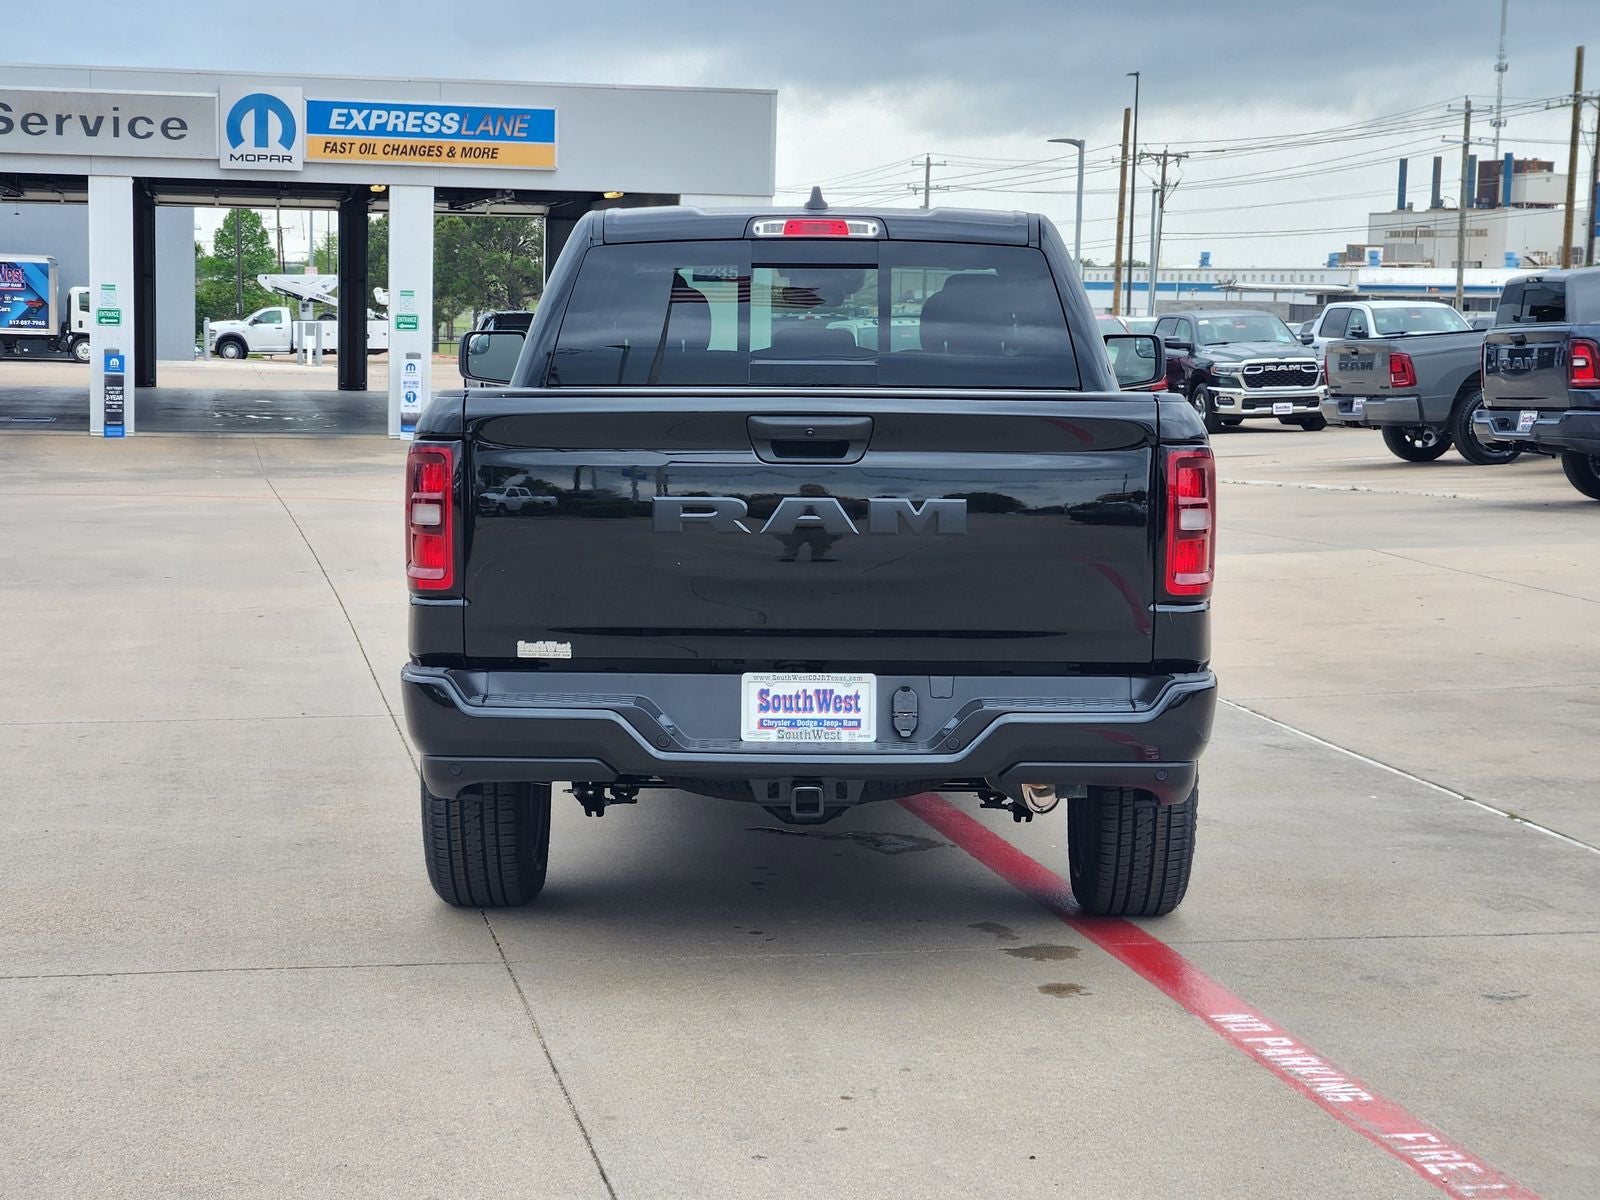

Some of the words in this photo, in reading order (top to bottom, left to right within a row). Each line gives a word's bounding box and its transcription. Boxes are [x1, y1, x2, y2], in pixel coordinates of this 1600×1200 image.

[0, 102, 189, 141] Service
[323, 141, 356, 155] FAST
[358, 143, 378, 156] OIL
[382, 144, 442, 158] CHANGES
[446, 148, 456, 158] &
[460, 147, 499, 159] MORE
[229, 153, 294, 164] MOPAR
[1264, 364, 1301, 372] RAM
[1339, 361, 1374, 371] RAM
[1500, 356, 1538, 370] RAM
[652, 496, 967, 535] RAM
[753, 674, 863, 682] www.SouthWestCDJRTexas.com
[757, 688, 861, 713] SouthWest
[762, 719, 791, 727] Chrysler
[796, 719, 818, 728] Dodge
[843, 719, 858, 727] Ram
[777, 729, 842, 740] SouthWest
[1207, 1013, 1273, 1032] NO
[1241, 1036, 1375, 1102] PARKING
[1381, 1132, 1485, 1176] FIRE
